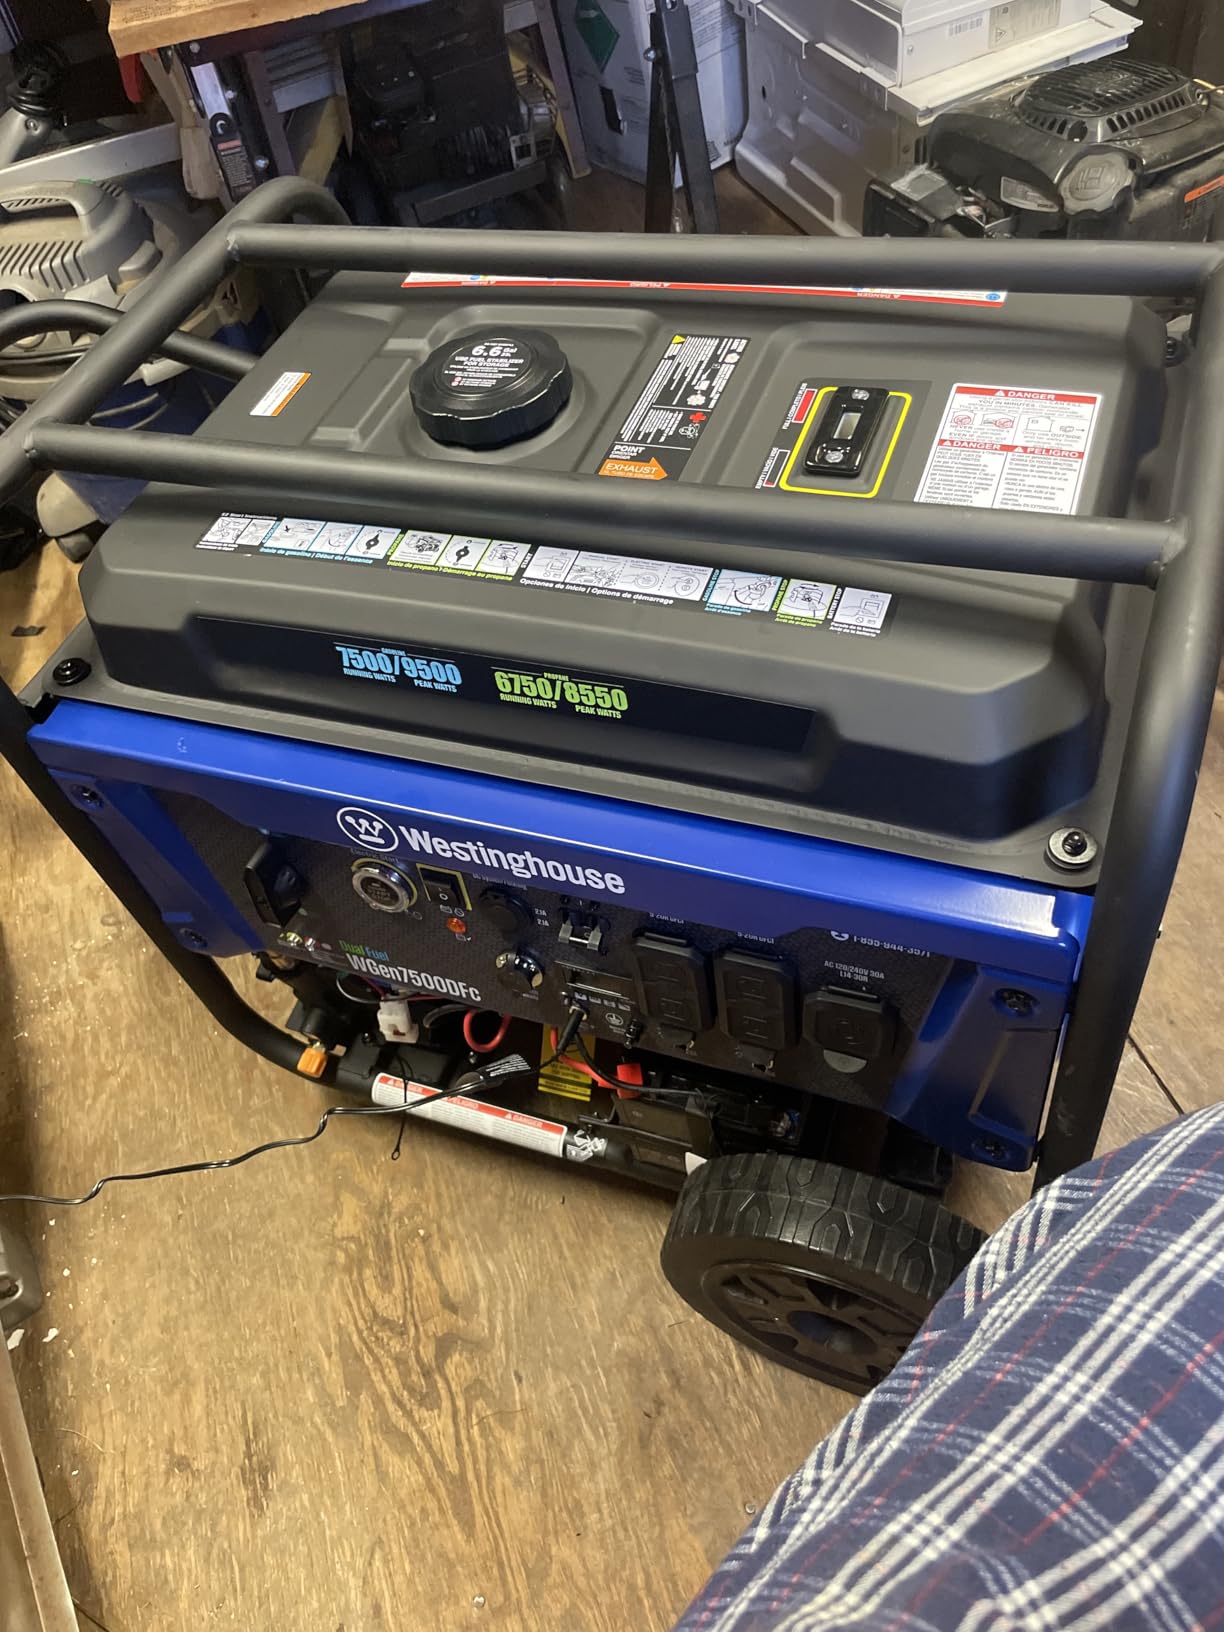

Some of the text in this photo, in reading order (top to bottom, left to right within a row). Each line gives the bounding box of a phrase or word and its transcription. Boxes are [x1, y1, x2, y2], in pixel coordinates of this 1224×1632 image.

[471, 345, 503, 357] 6.6
[1007, 391, 1056, 401] DANGER
[613, 444, 646, 453] POINT
[953, 441, 1001, 450] DANGER
[1027, 448, 1079, 458] PELIGRO
[606, 463, 658, 474] EXHAUST
[520, 553, 533, 569] START
[519, 577, 554, 588] Opciones
[591, 587, 621, 598] Options
[632, 592, 674, 605] démarrage
[335, 646, 463, 685] 7500/9500
[343, 668, 396, 683] RUNNING WATTS
[414, 679, 457, 693] PEAK WATTS
[494, 671, 629, 711] 6750/8550
[500, 693, 557, 709] RUNNING WATTS
[575, 705, 622, 719] PEAK WATTS
[398, 825, 626, 894] Westinghouse
[339, 940, 389, 961] Dual Fuel
[824, 960, 885, 979] AC 120/240V 30A
[346, 953, 482, 1002] WGen7500DFc
[512, 1114, 543, 1128] DANGER
